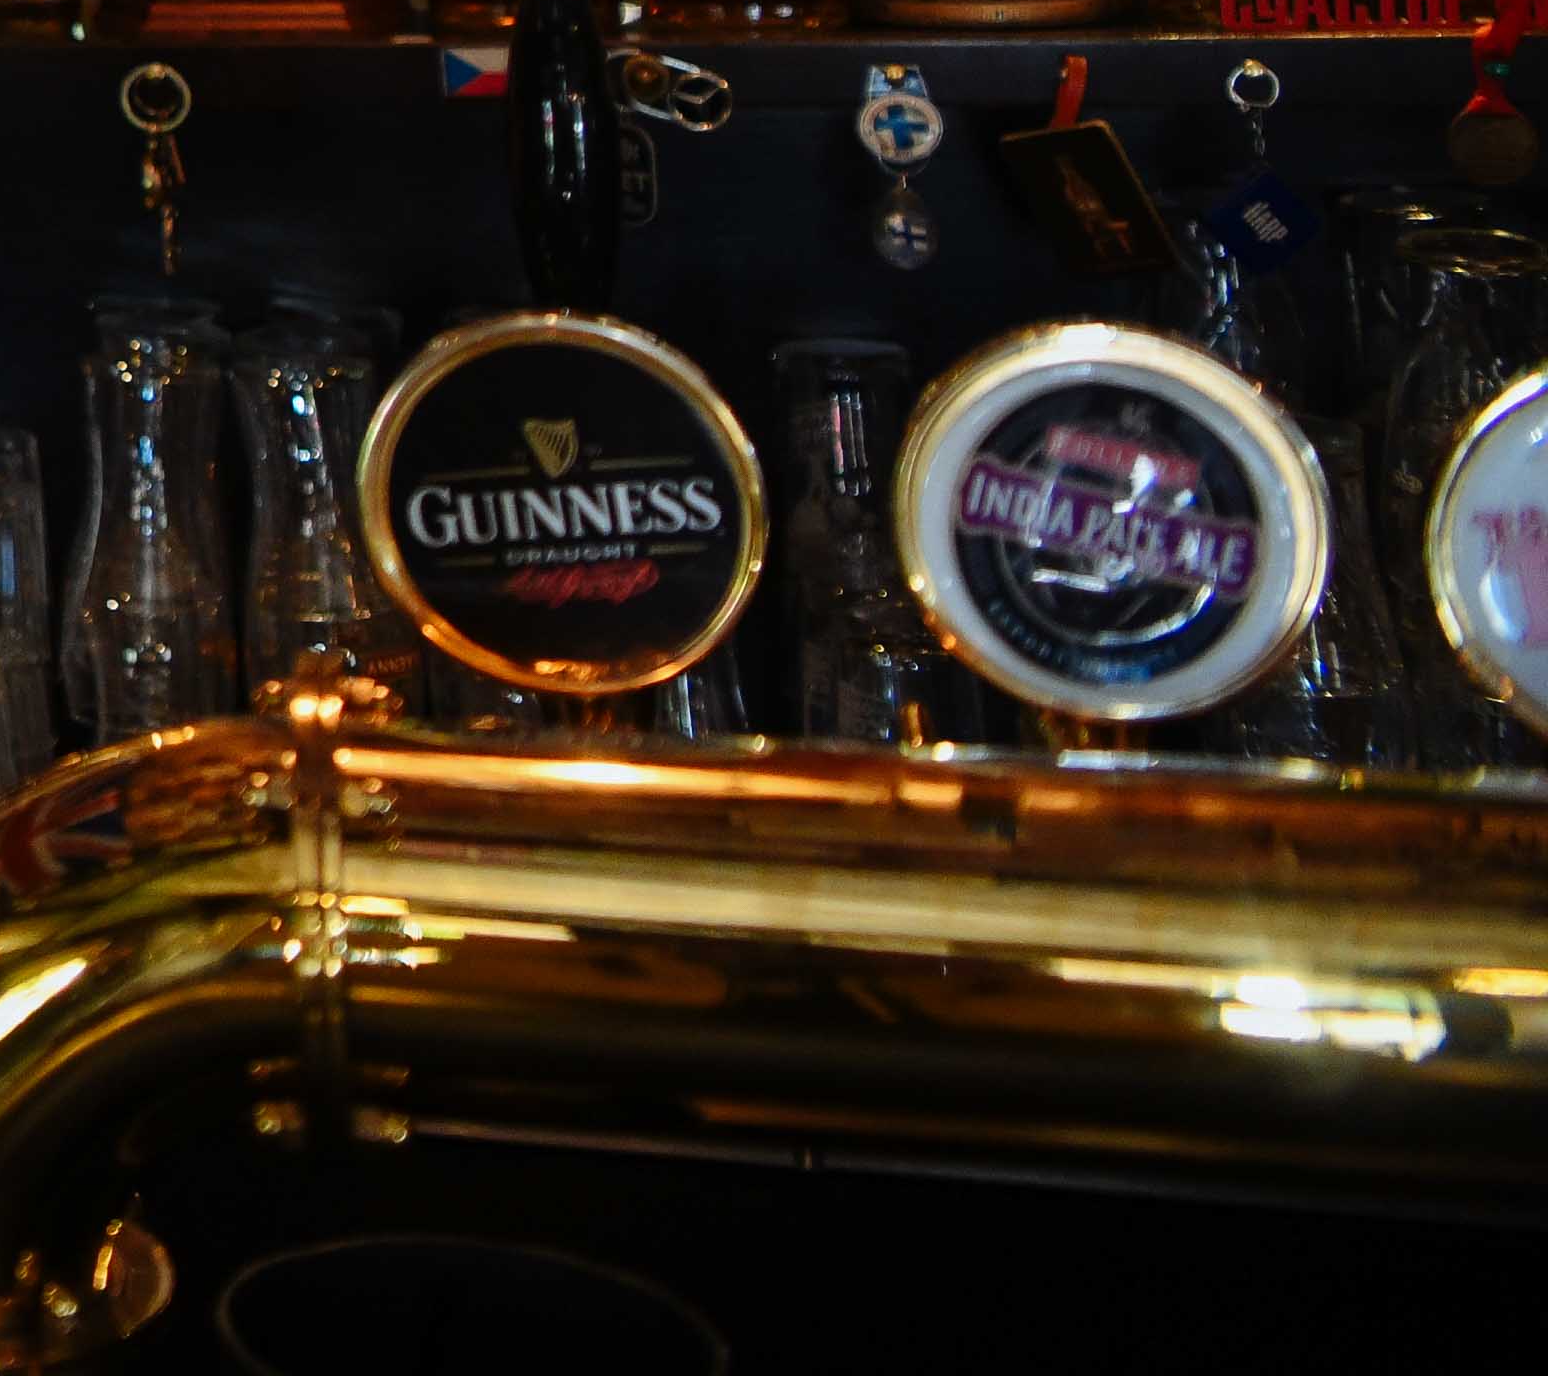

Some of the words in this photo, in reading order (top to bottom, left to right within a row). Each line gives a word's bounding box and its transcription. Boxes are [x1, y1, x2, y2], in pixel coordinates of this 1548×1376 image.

[406, 476, 725, 549] GUINNESS
[966, 472, 1076, 542] INDIA
[1175, 526, 1251, 583] ALE
[504, 543, 639, 567] DRAUGHT
